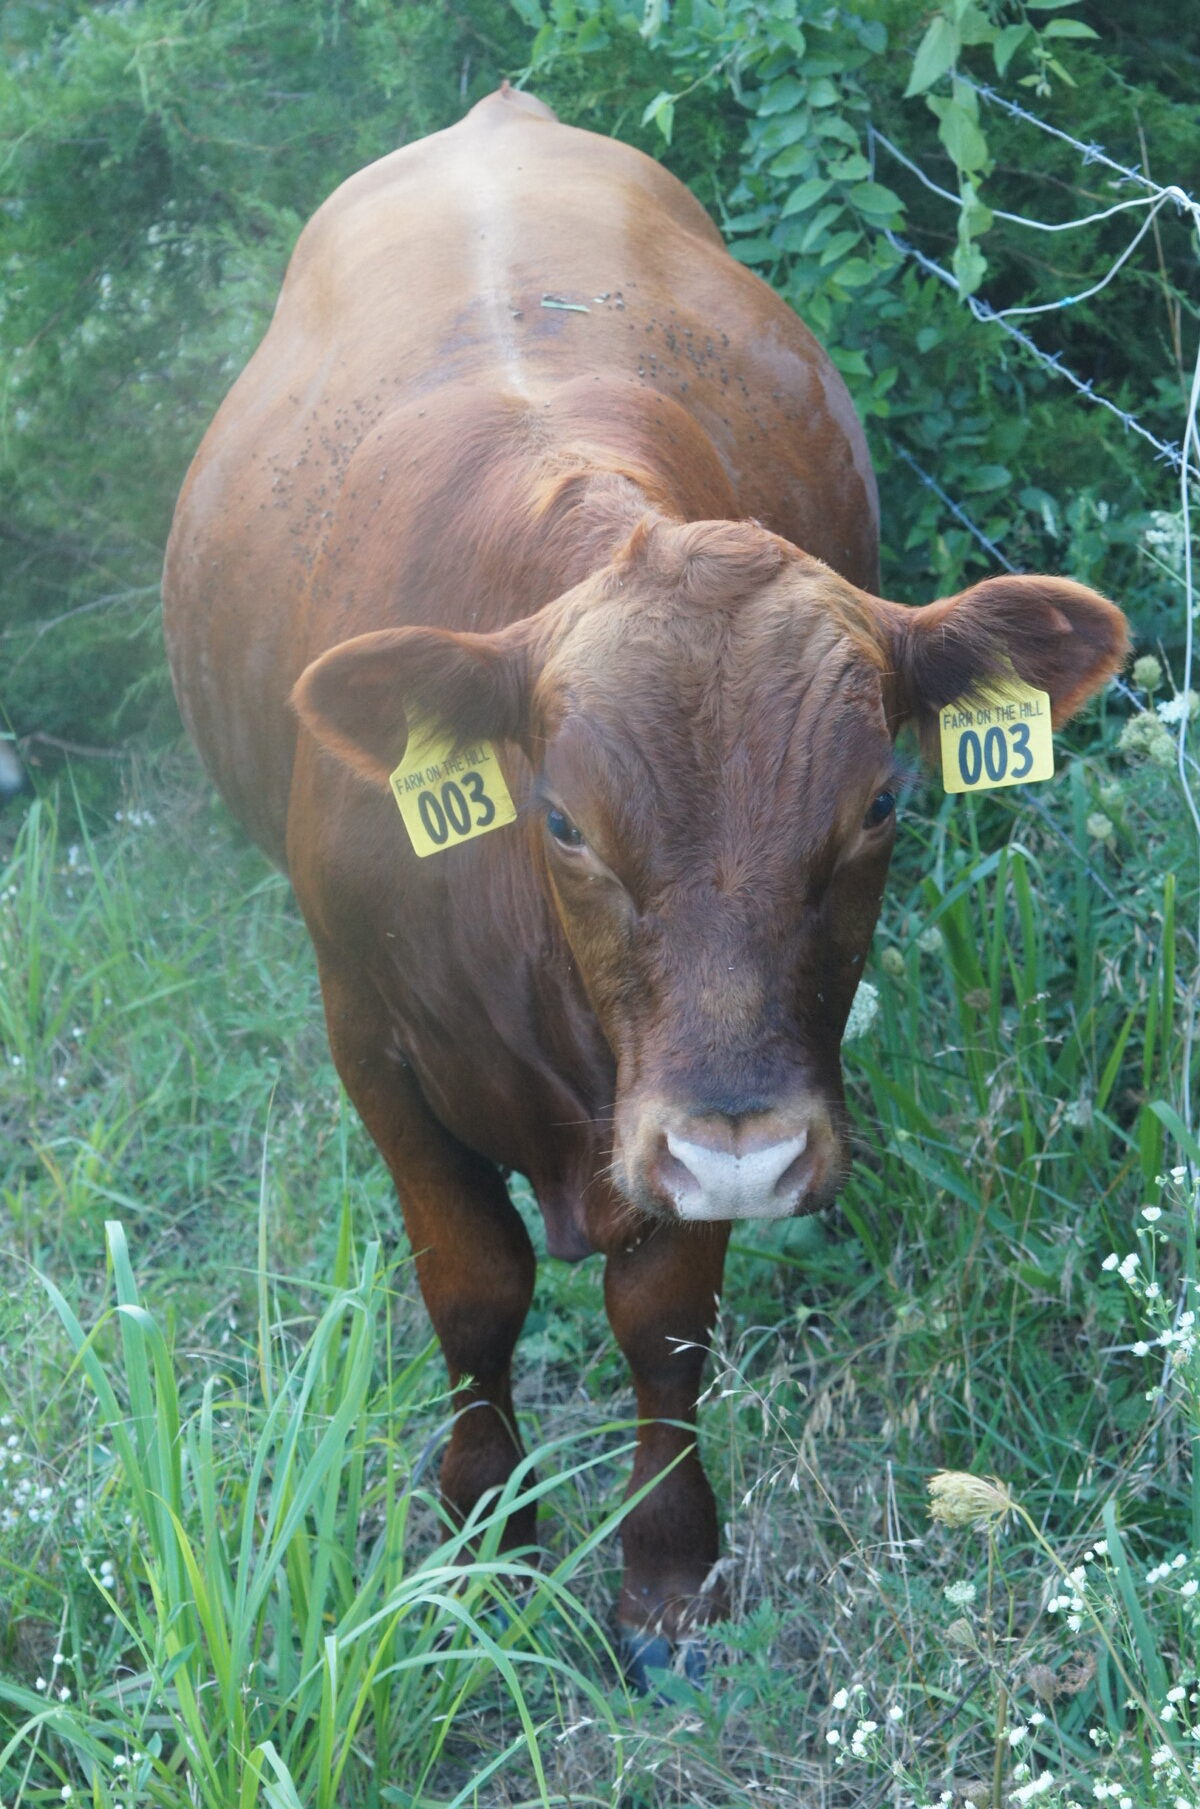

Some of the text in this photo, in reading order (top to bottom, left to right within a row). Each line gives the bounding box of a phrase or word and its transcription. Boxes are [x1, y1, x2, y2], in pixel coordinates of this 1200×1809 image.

[943, 700, 1044, 730] FARM ON THE HILL
[395, 746, 490, 796] FARM ON THE HILL
[958, 722, 1034, 785] 003
[417, 771, 496, 845] 003
